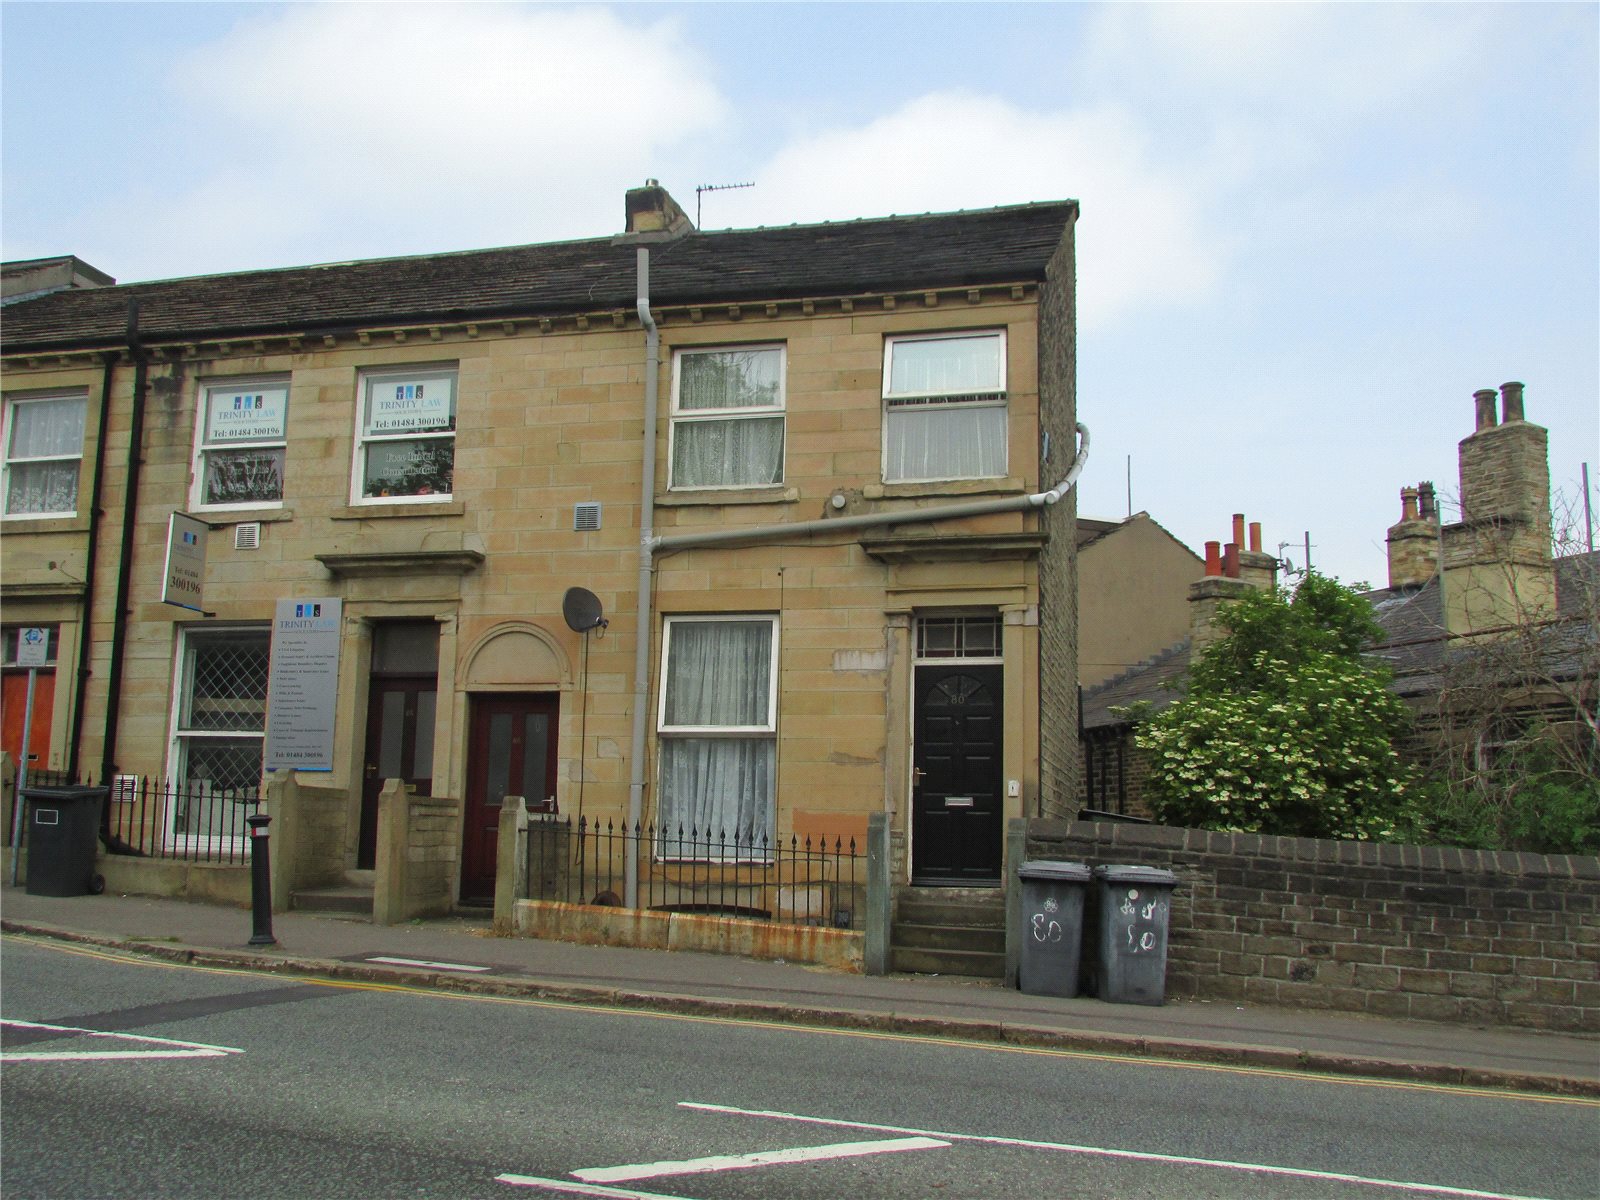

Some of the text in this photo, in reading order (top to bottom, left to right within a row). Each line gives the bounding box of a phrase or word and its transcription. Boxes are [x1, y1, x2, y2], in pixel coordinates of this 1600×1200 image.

[380, 399, 441, 410] TRINITY LAW
[218, 408, 275, 420] TRINITY LAW
[375, 417, 446, 428] Tel: 01484 300196
[213, 427, 280, 437] Tel: 01484 300196
[170, 576, 200, 594] 300196
[280, 620, 313, 629] TRINITY
